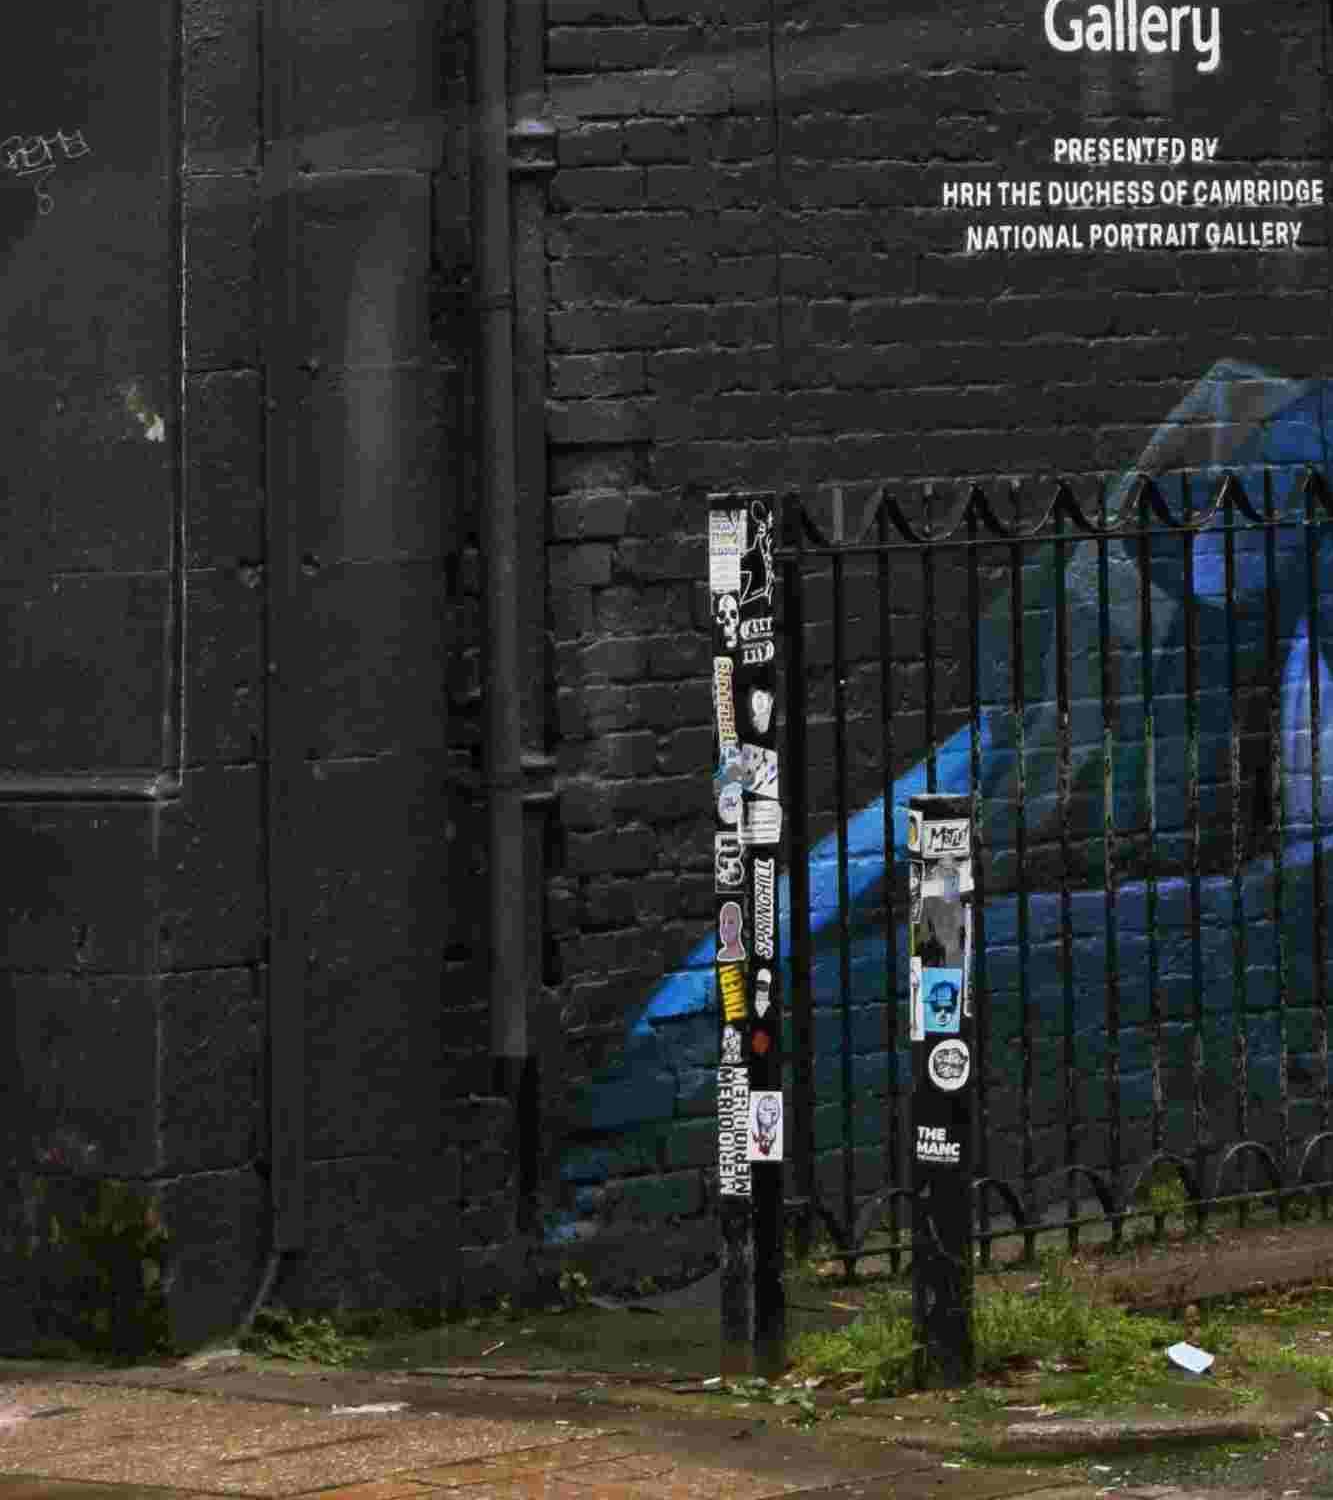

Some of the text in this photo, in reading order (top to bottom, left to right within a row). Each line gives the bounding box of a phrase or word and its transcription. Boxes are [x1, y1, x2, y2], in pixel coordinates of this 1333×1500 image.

[1053, 137, 1219, 164] PRESENTED BY
[943, 179, 1324, 207] HRH THE DUCHESS OF CAMBRIDGE
[966, 221, 1302, 252] NATIONAL PORTRAIT GALLERY
[916, 1125, 947, 1141] THE
